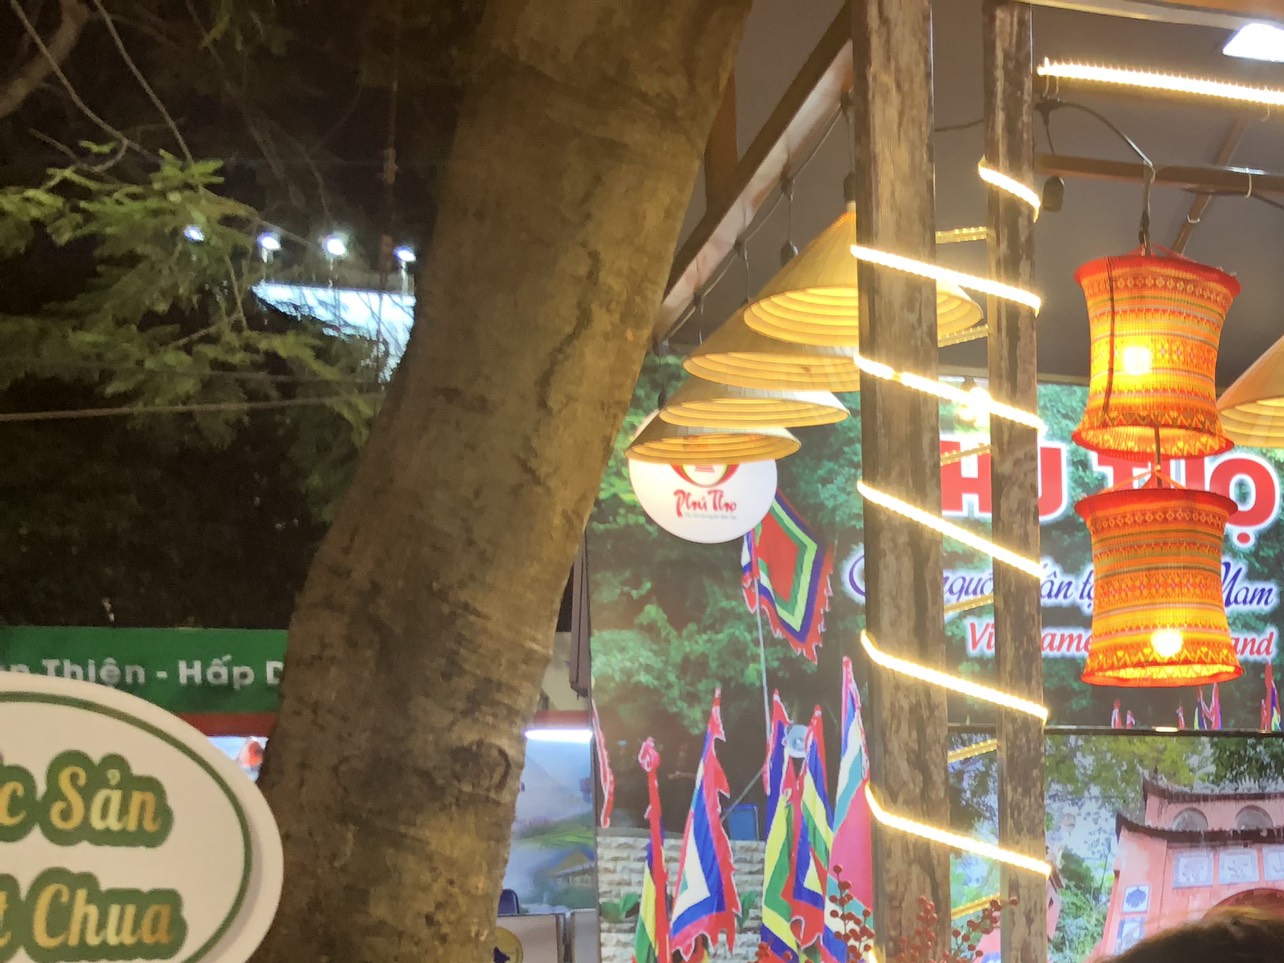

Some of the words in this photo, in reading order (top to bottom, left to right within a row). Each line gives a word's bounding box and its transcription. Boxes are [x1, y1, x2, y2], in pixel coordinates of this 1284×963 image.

[178, 654, 255, 690] Hấp
[50, 765, 161, 832] Sản
[32, 883, 172, 948] Chua
